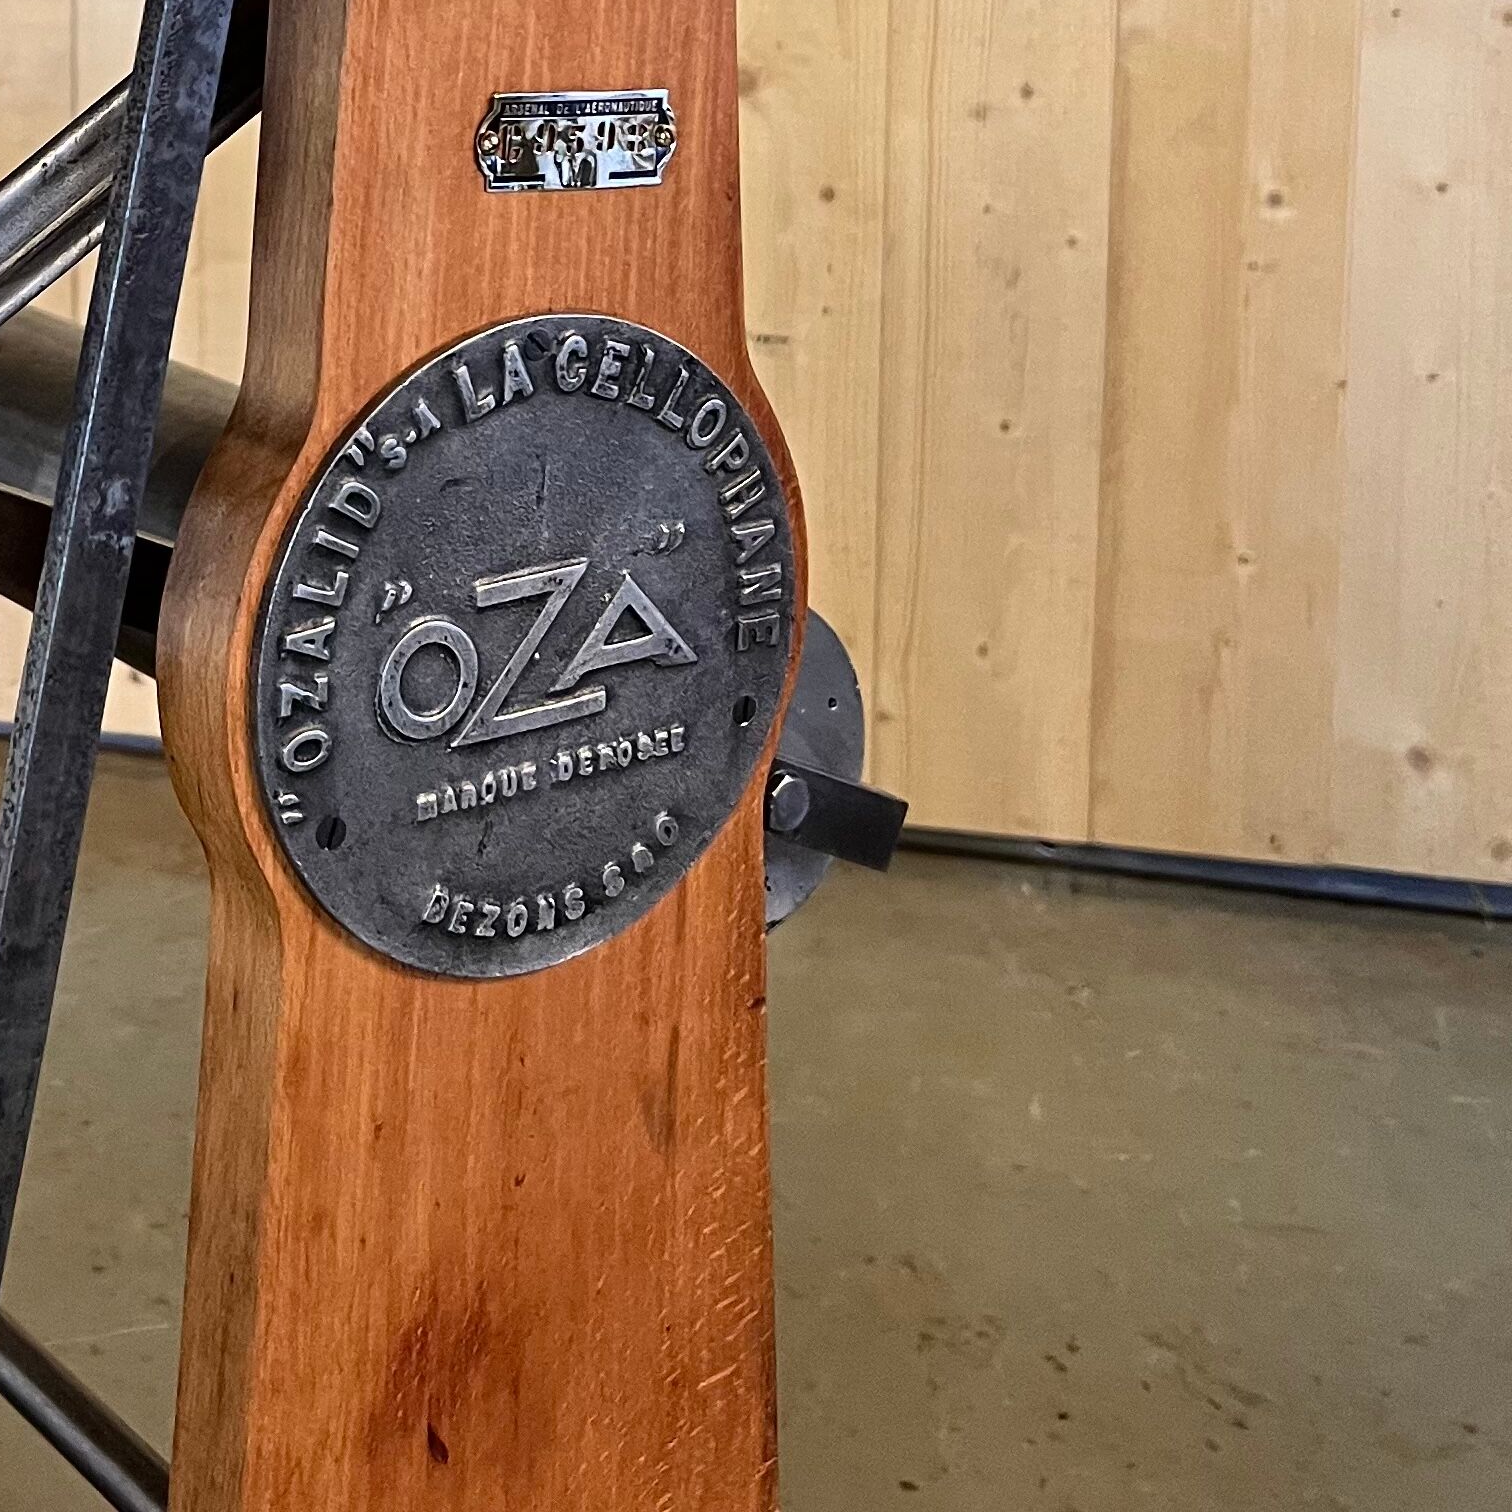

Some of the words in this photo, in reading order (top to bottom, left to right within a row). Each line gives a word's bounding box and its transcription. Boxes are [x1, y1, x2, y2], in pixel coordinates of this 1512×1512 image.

[452, 341, 535, 424] LA
[554, 334, 782, 653] CELLOPHANE
[415, 760, 538, 823] MARQUE
